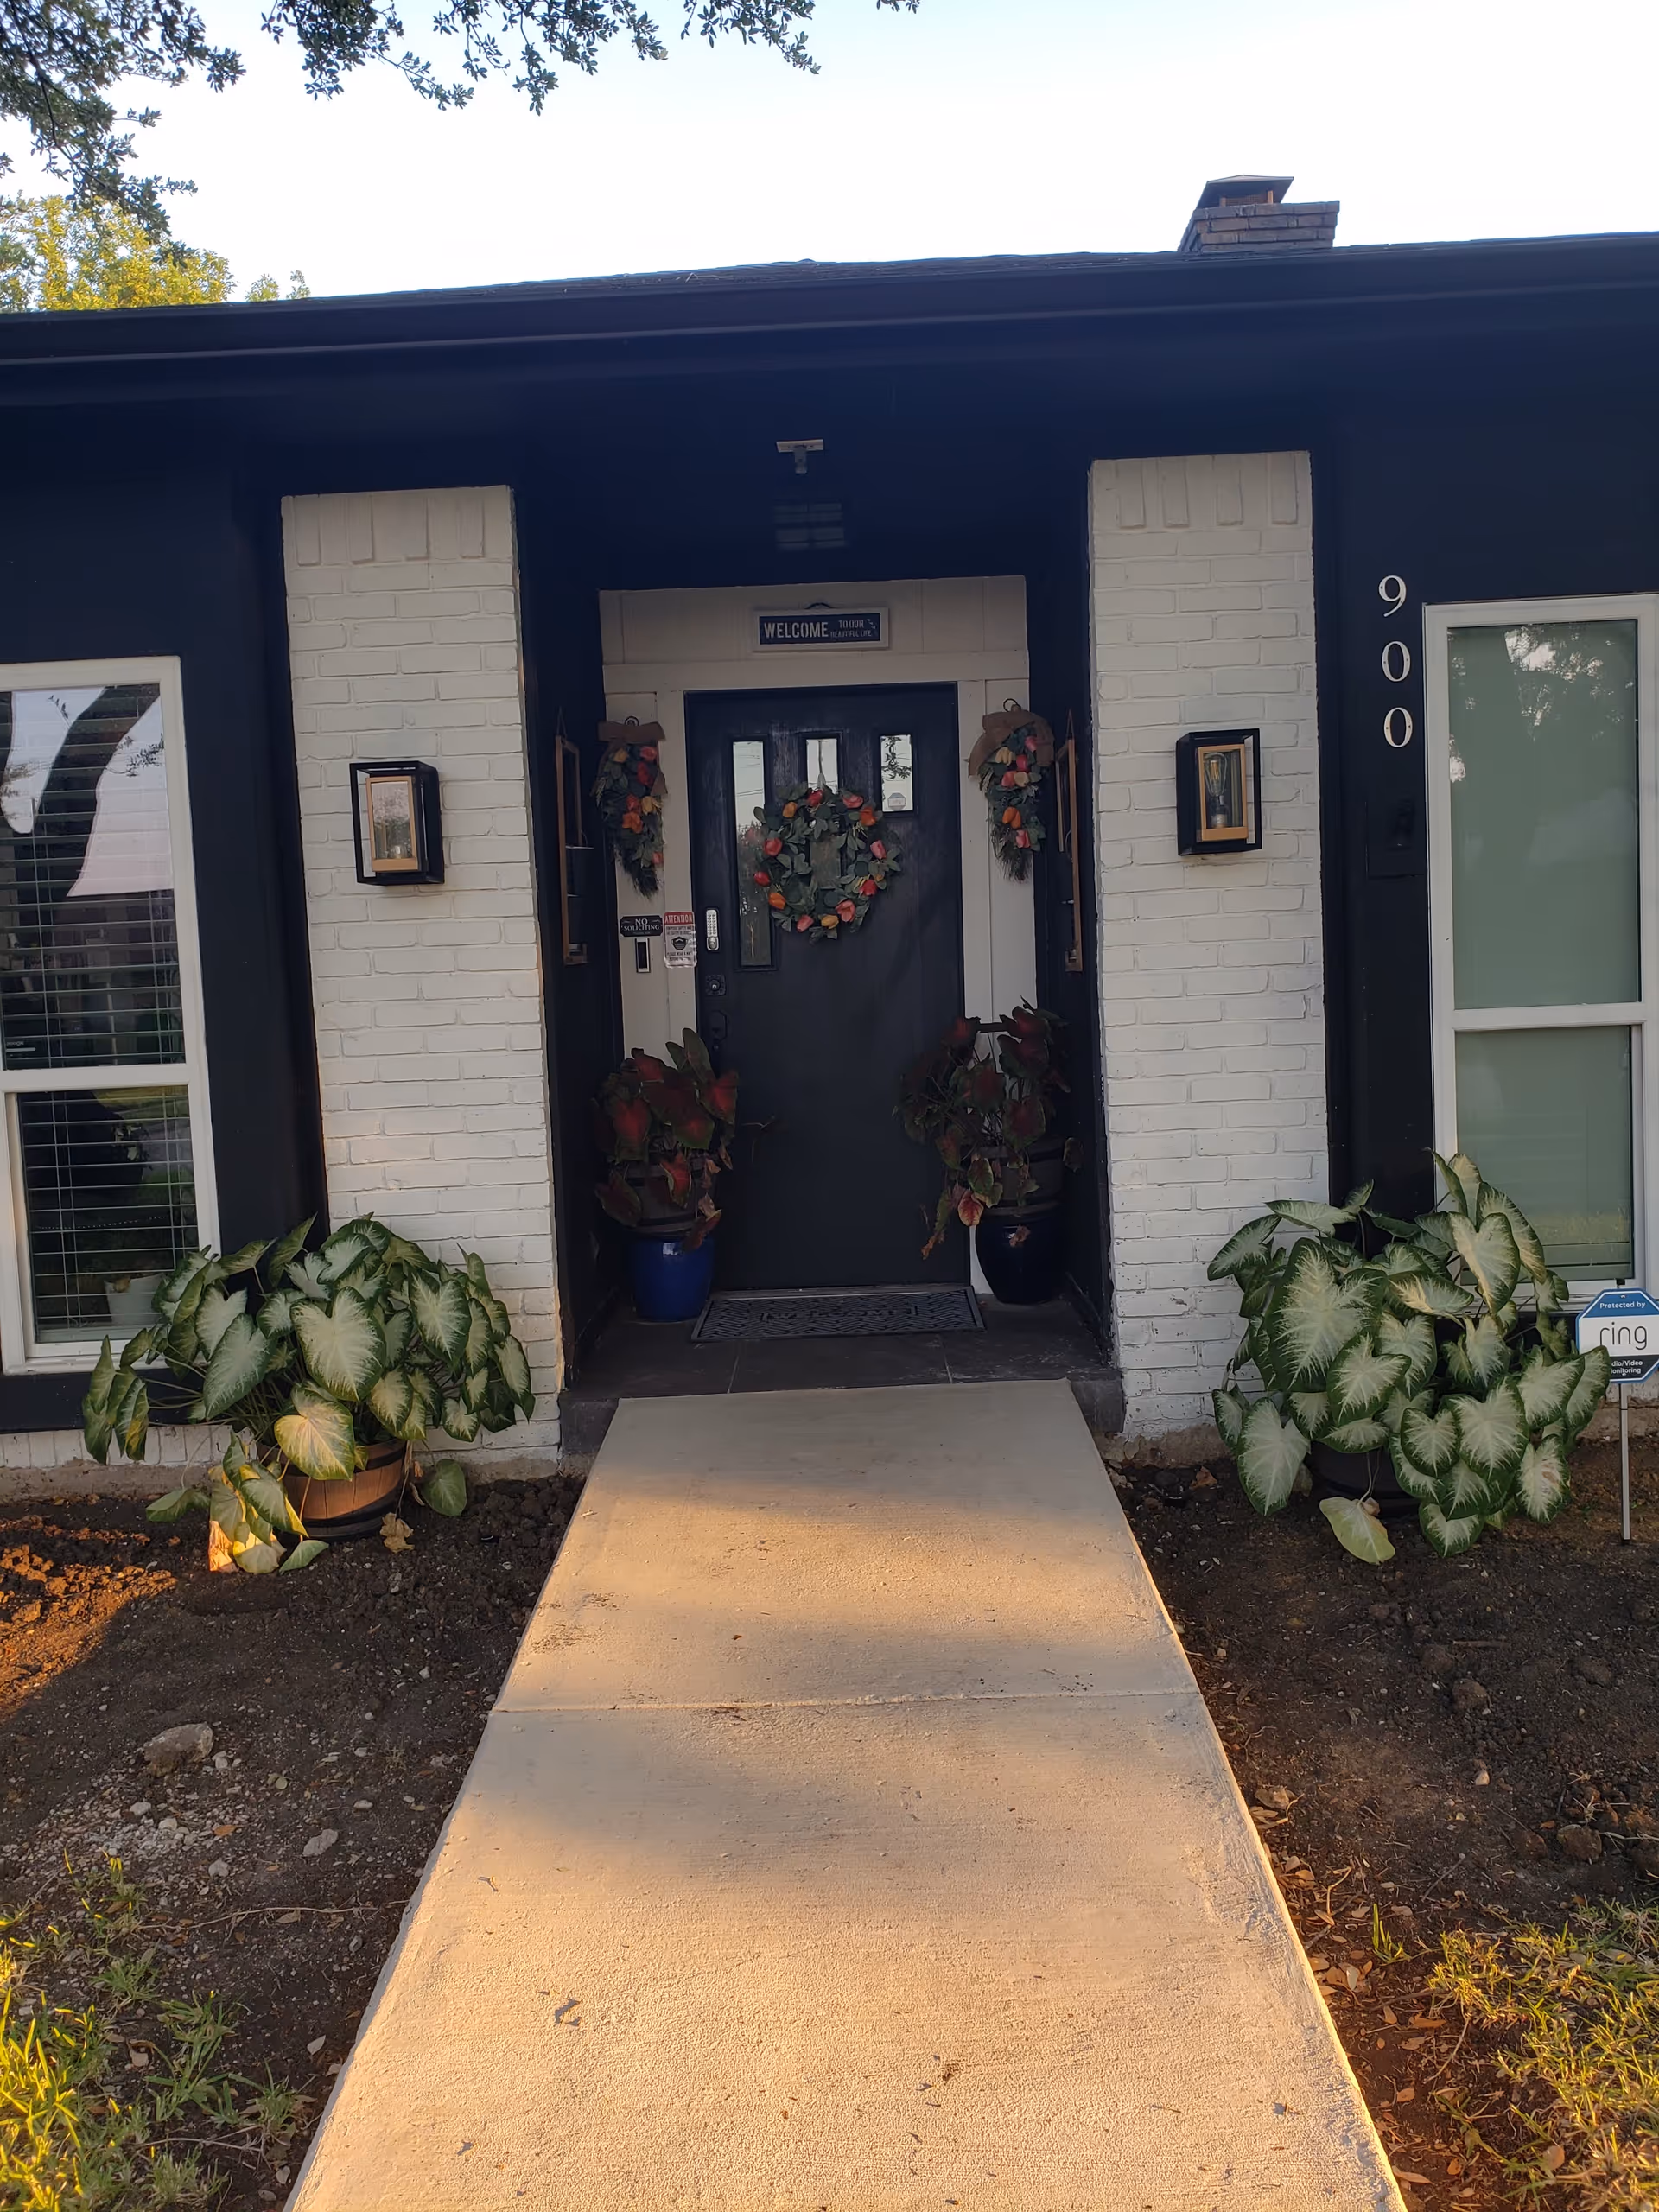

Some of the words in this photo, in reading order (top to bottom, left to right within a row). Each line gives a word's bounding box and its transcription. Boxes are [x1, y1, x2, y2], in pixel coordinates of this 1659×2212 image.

[764, 622, 829, 638] WELCOME
[839, 620, 848, 629] TO
[849, 620, 864, 628] OUR
[664, 914, 692, 923] ATTENTION
[1599, 1321, 1647, 1351] ring
